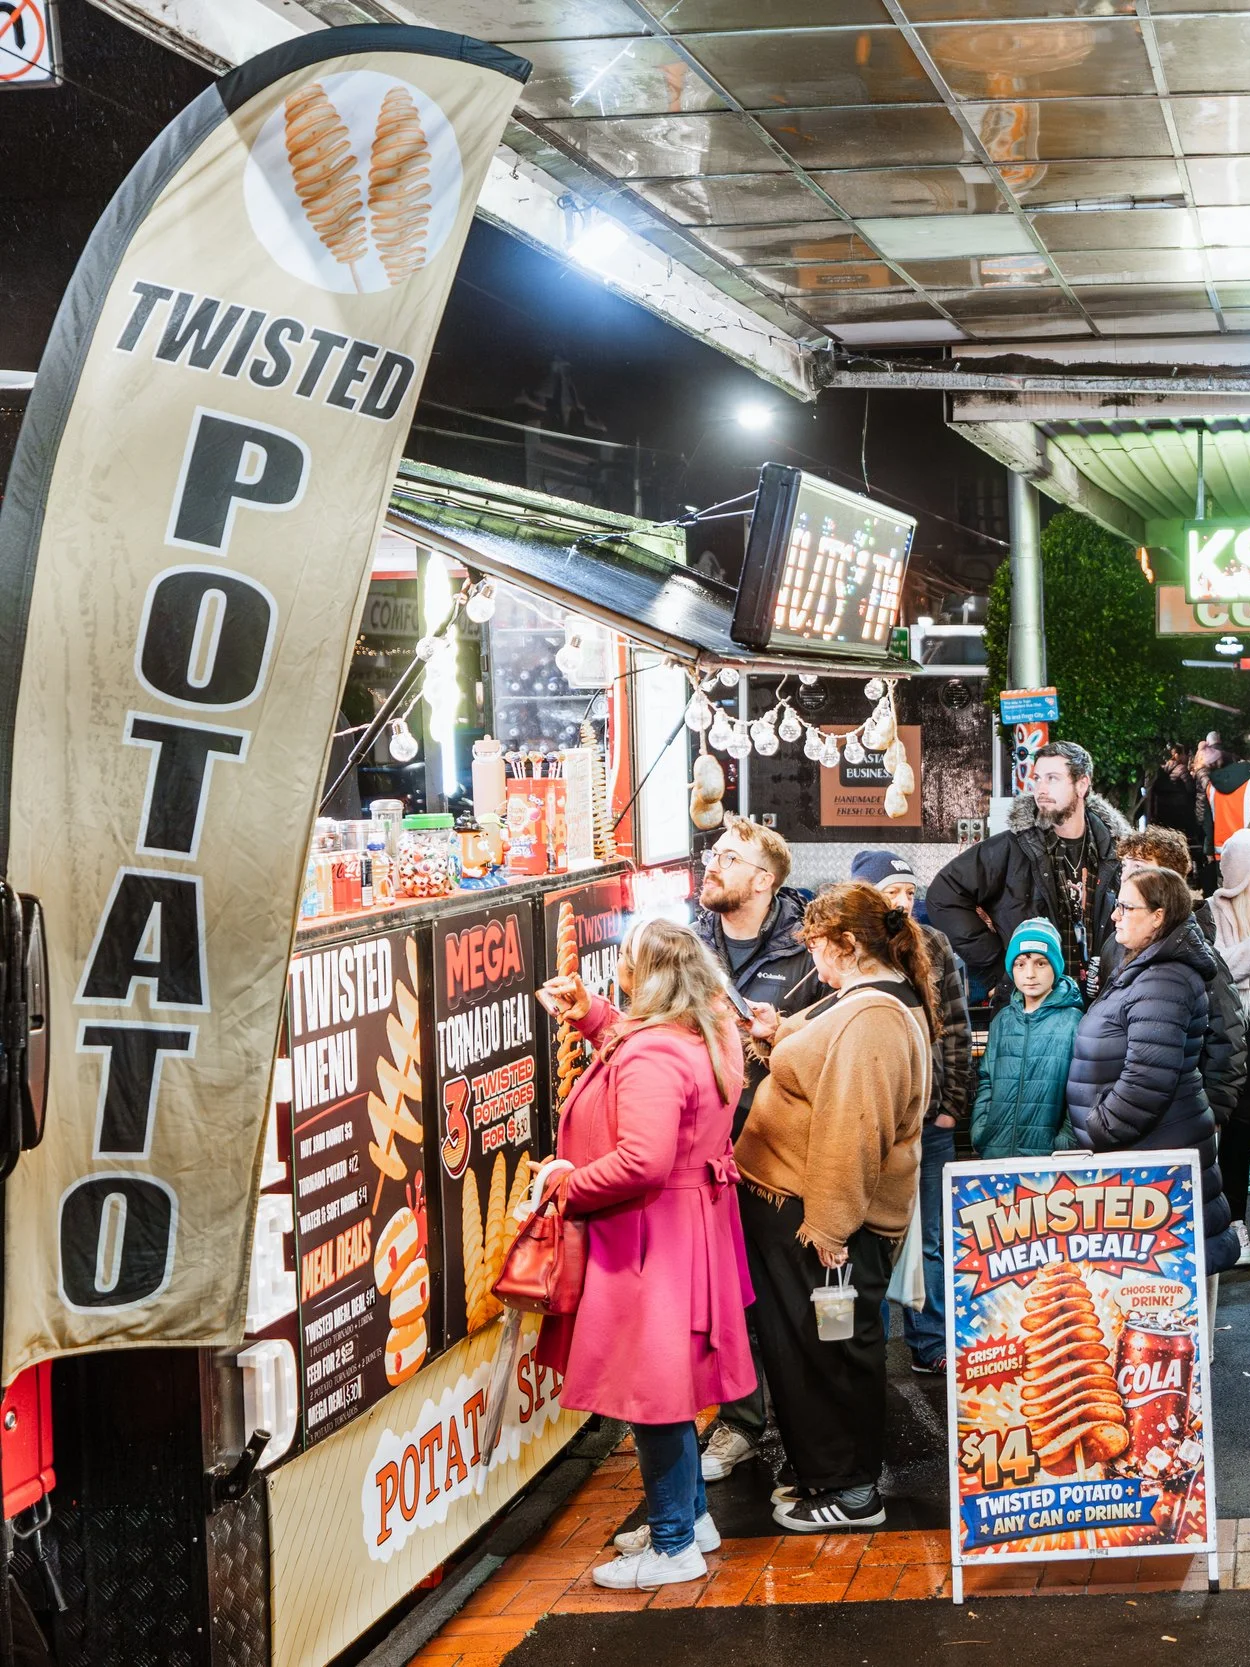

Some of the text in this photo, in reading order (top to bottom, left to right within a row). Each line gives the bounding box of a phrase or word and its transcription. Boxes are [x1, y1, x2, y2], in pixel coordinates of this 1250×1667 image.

[115, 280, 417, 422] TWISTED
[862, 753, 885, 764] ASTA
[834, 795, 882, 803] HANDMADE
[865, 807, 876, 815] TO
[58, 405, 311, 1315] POTATO
[576, 906, 621, 948] TWISTED
[446, 917, 523, 1003] MEGA
[581, 950, 601, 984] MEAL
[289, 937, 393, 1037] TWISTED
[438, 992, 532, 1077] TORNADO DEAL
[294, 1028, 358, 1113] MENU
[472, 1055, 535, 1100] TWISTED
[473, 1082, 535, 1131] POTATOES
[442, 1075, 471, 1179] 3
[482, 1127, 505, 1155] FOR
[300, 1206, 321, 1235] WATER
[959, 1186, 1173, 1252] TWISTED
[302, 1217, 372, 1303] MEAL DEALS
[989, 1233, 1156, 1279] MEAL DEAL!
[1120, 1284, 1184, 1297] CHOOSE YOUR
[1131, 1295, 1174, 1307] DRINK!
[305, 1312, 333, 1346] TWISTED
[333, 1302, 351, 1331] MEAL
[351, 1294, 366, 1321] DEAL
[306, 1359, 322, 1388] FEED
[322, 1353, 336, 1379] FOR
[966, 1355, 1023, 1379] DELICIOUS!
[967, 1343, 1017, 1365] CRISPY &
[314, 1378, 333, 1398] POTATO
[334, 1362, 358, 1388] TORNADOS
[1118, 1359, 1181, 1394] COLA
[308, 1403, 328, 1429] MEGA
[328, 1390, 344, 1417] DEAL
[314, 1421, 334, 1441] POTATO
[334, 1405, 358, 1430] TORNADOS
[376, 1388, 502, 1547] POTAT
[961, 1427, 1035, 1485] $14
[976, 1490, 1055, 1518] TWISTED
[1060, 1484, 1122, 1505] POTATO
[993, 1501, 1142, 1535] ANY CAN OF DRINK!
